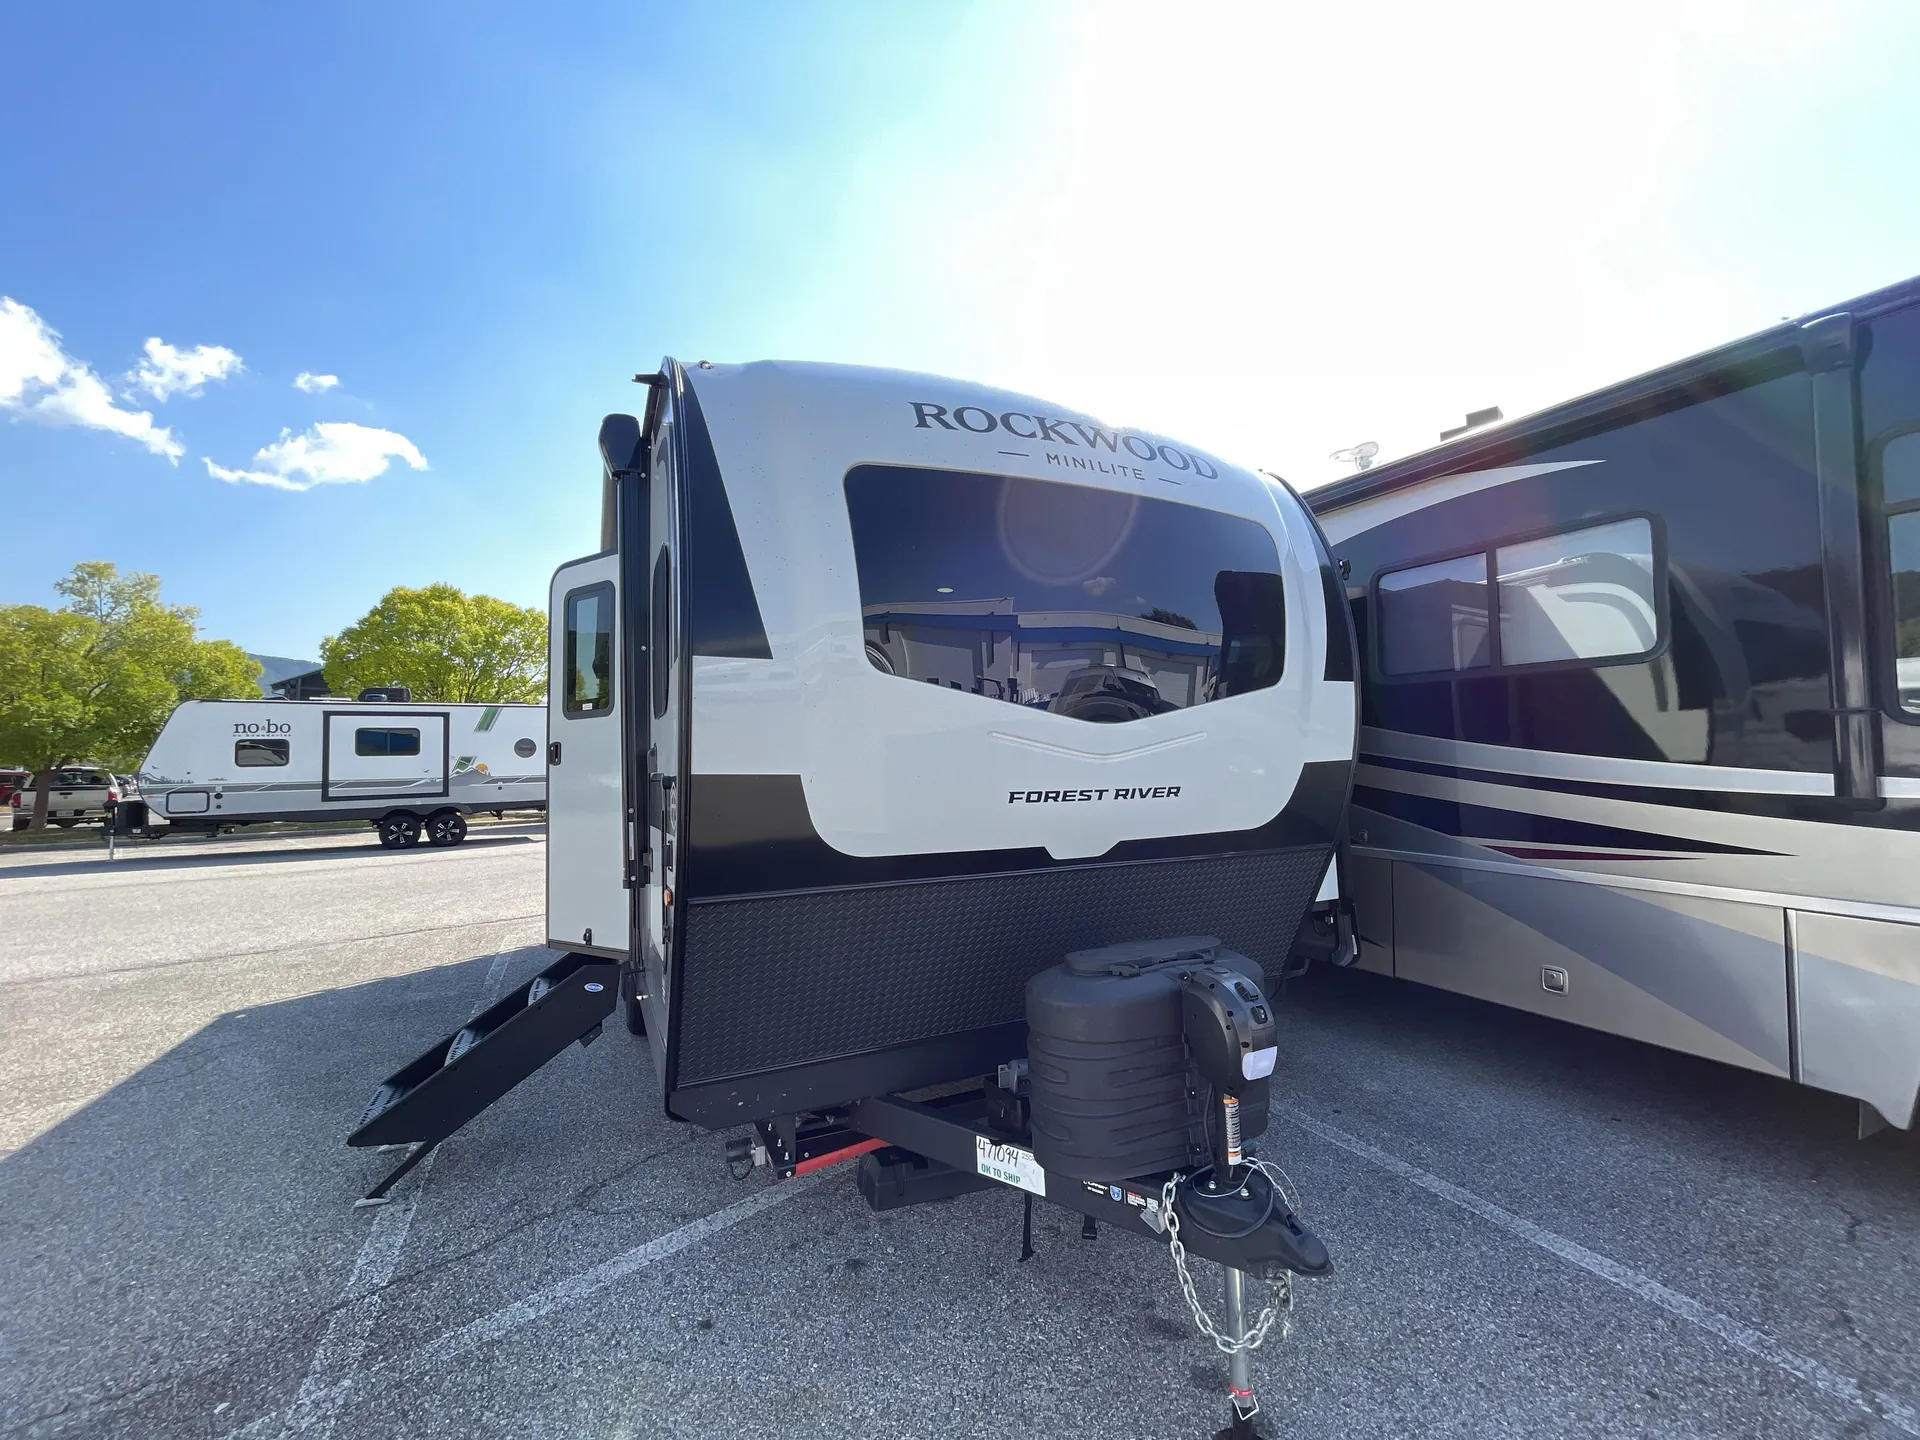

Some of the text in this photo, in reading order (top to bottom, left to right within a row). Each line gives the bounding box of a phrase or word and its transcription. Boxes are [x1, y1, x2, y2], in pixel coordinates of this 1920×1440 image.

[907, 401, 1219, 480] ROCKWOOD
[1045, 452, 1145, 481] MINILITE
[1008, 786, 1181, 804] FOREST RIVER
[981, 1163, 1021, 1184] OK TO SHIP
